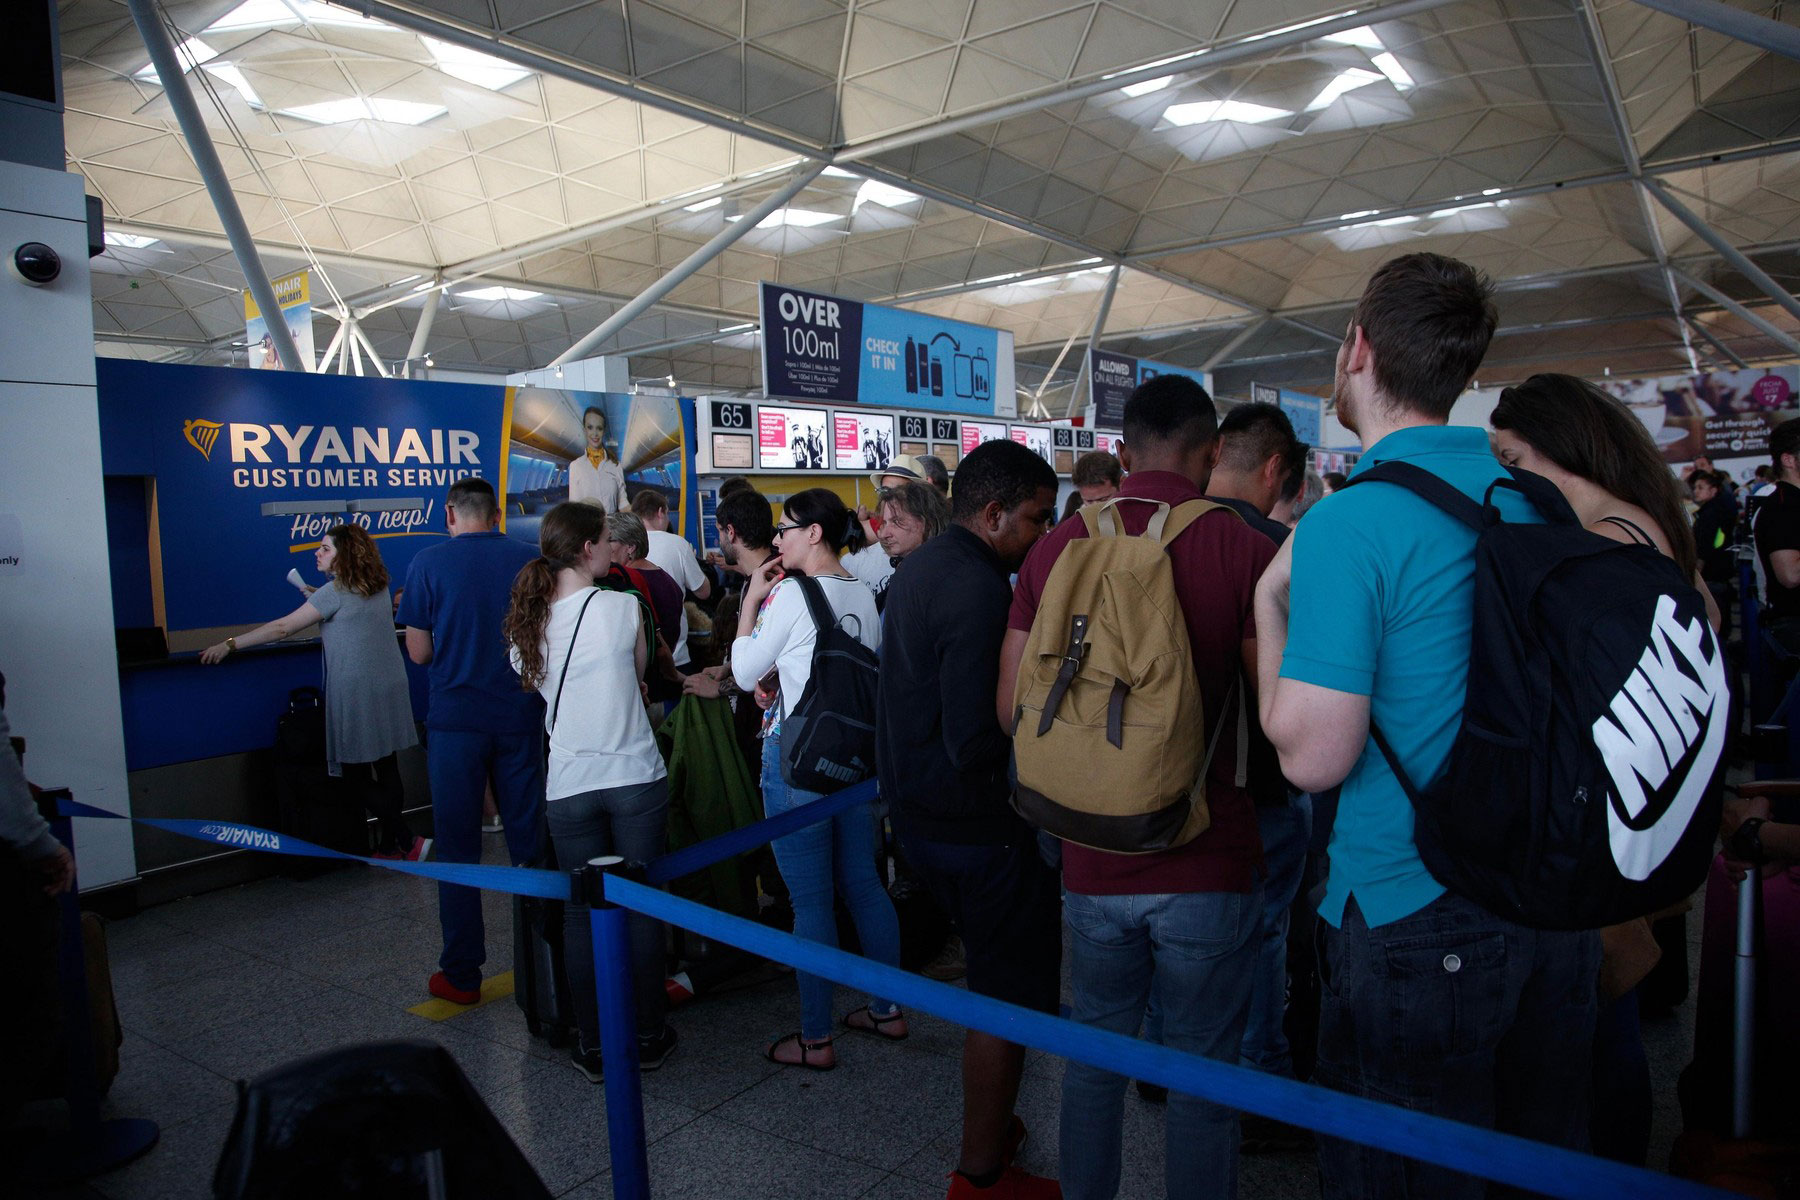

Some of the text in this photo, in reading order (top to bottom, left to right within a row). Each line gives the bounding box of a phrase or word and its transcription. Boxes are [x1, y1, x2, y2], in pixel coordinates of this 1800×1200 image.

[273, 277, 300, 294] NAIR
[779, 292, 841, 328] OVER
[783, 326, 840, 360] 100ml
[866, 337, 900, 356] CHECK
[872, 355, 896, 371] IT IN
[1099, 359, 1130, 376] ALLOWED
[1094, 371, 1105, 383] ON
[1105, 374, 1114, 385] ALL
[1760, 380, 1783, 388] FROM
[721, 404, 744, 427] 65
[1704, 417, 1765, 429] Get through
[905, 418, 922, 437] 66
[938, 420, 952, 438] 67
[1706, 430, 1744, 440] security
[229, 422, 481, 465] RYANAIR
[1057, 430, 1069, 446] 68
[1080, 432, 1090, 447] 69
[1706, 441, 1728, 450] with
[233, 468, 378, 488] CUSTOMER
[0, 556, 19, 566] nly
[1592, 594, 1716, 820] NIKE
